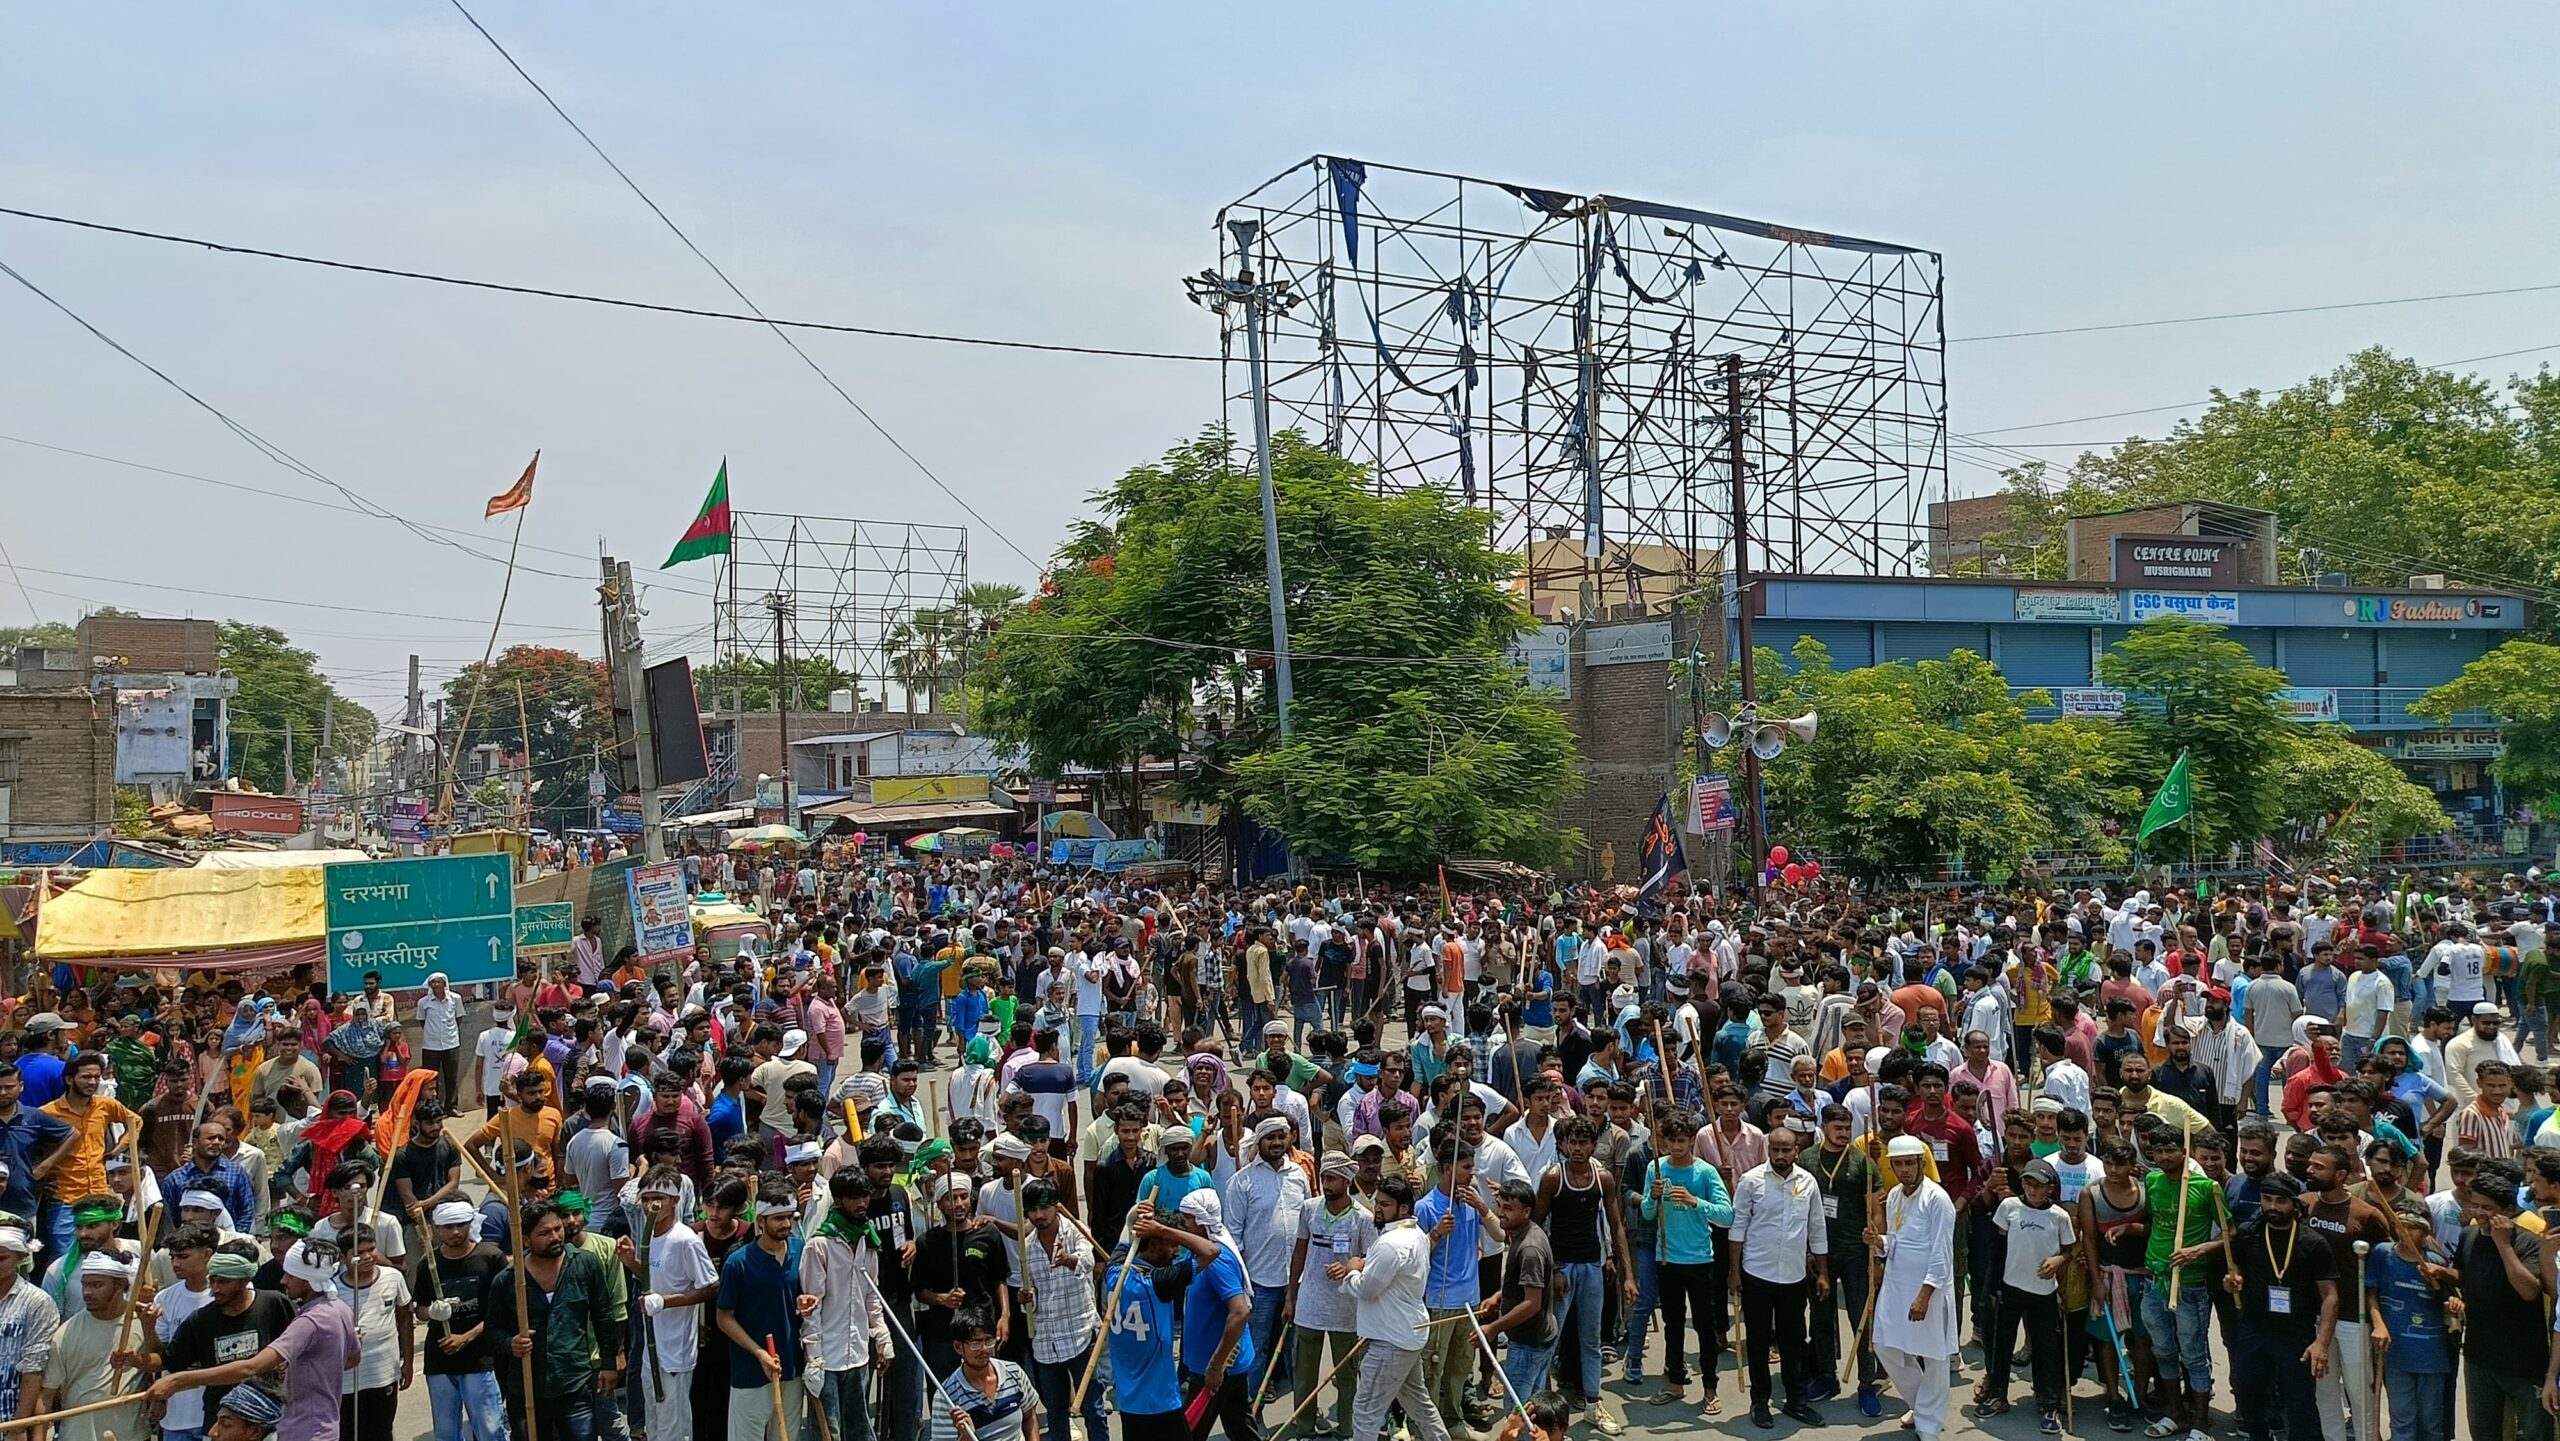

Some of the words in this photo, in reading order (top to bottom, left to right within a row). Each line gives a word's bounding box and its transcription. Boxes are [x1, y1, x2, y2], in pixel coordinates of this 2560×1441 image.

[2133, 546, 2181, 561] CENTRE
[2183, 548, 2219, 562] POINT
[2144, 566, 2212, 578] MUSRIGHARARI
[2134, 593, 2160, 608] CSC
[2358, 597, 2389, 622] RJ
[2390, 600, 2463, 621] Fashion
[2064, 693, 2080, 702] CSC
[251, 811, 294, 821] CYCLES
[340, 881, 411, 904] दरभंगा
[343, 942, 440, 969] समस्तीपुर
[2467, 961, 2480, 975] 18
[2309, 1216, 2346, 1233] Create
